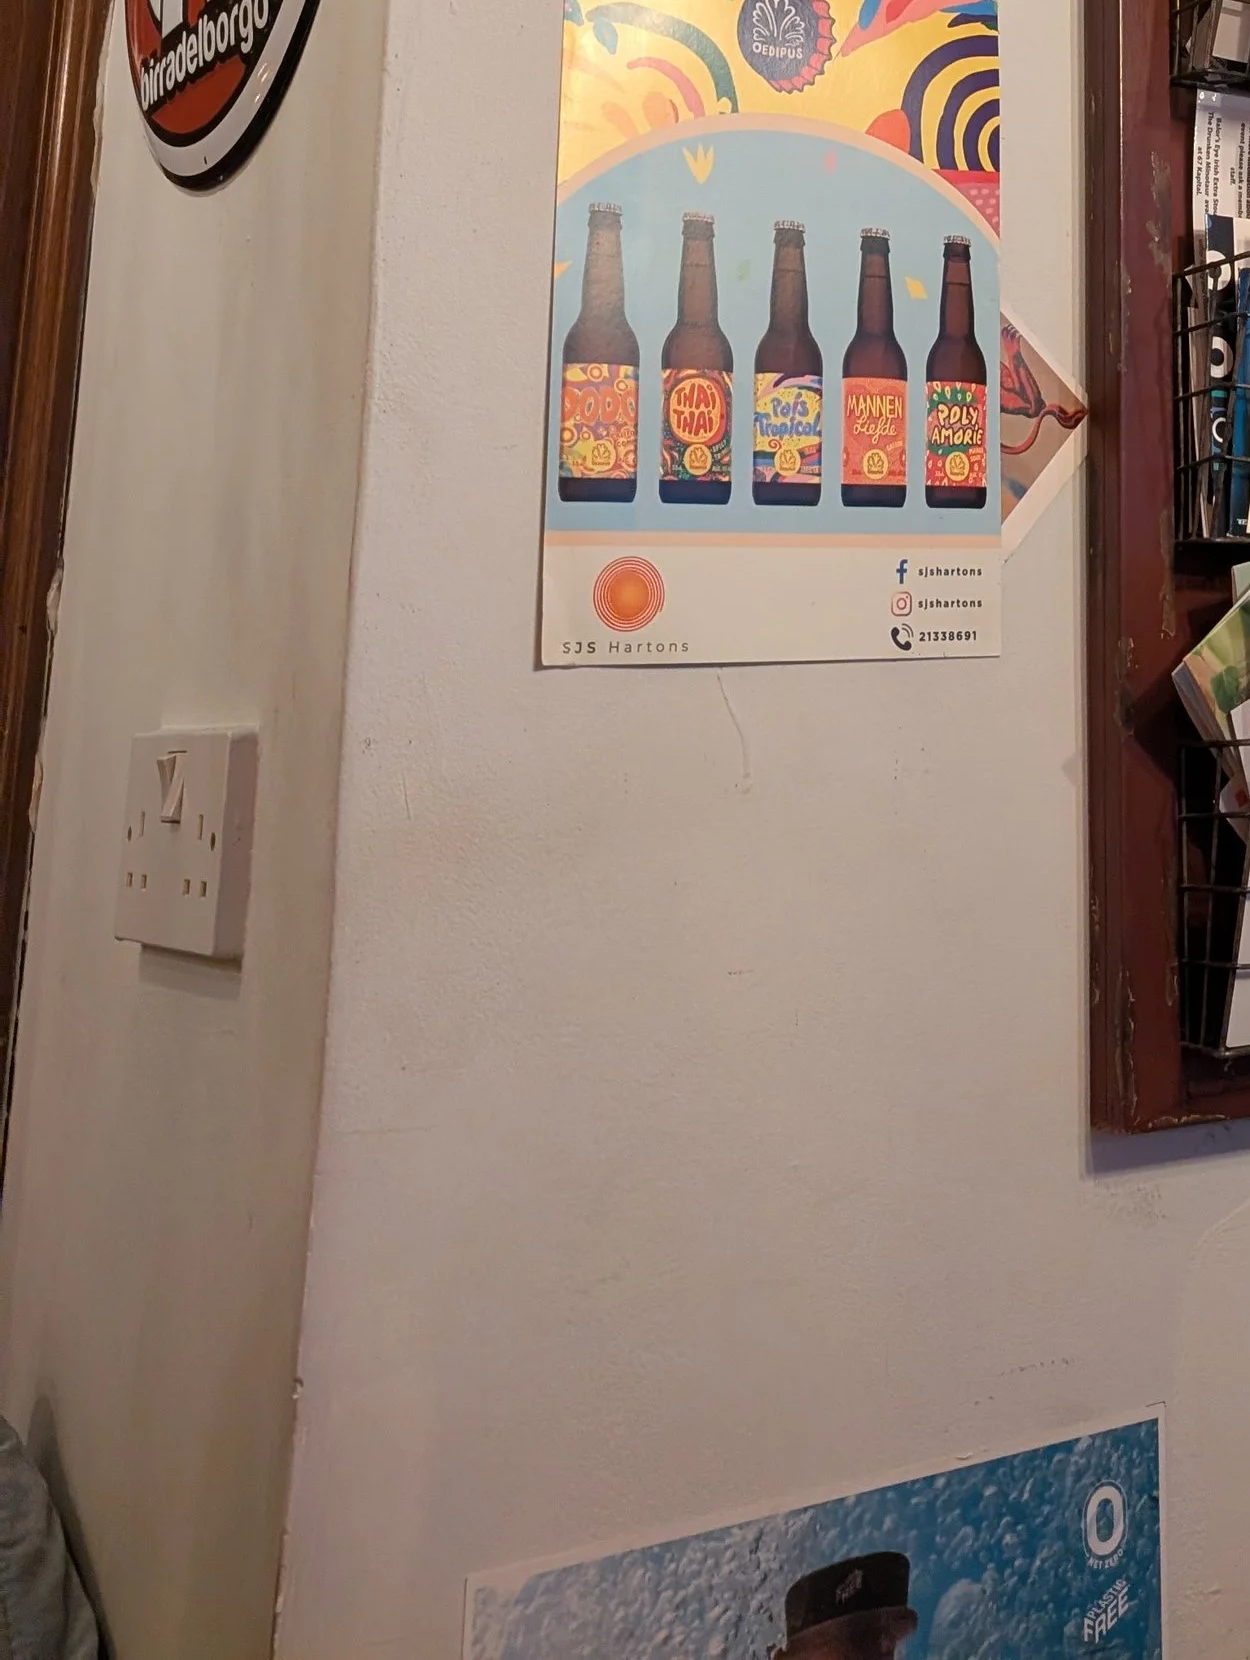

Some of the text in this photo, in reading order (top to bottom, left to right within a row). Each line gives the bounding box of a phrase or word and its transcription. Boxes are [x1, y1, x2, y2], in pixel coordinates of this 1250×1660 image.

[752, 41, 804, 60] OEDIPUS
[1206, 126, 1214, 158] Drunken
[1204, 160, 1212, 195] Minotaur
[847, 395, 903, 419] MANNEN
[936, 403, 980, 427] POLY
[853, 416, 897, 444] Liefde
[931, 426, 984, 446] AMORIE
[918, 566, 983, 578] sjshartons
[918, 598, 983, 610] sjshartons
[562, 640, 690, 655] SJS Hartons
[919, 630, 977, 642] 21338691
[1086, 1577, 1128, 1620] PLASTIC
[1083, 1584, 1131, 1644] FREE
